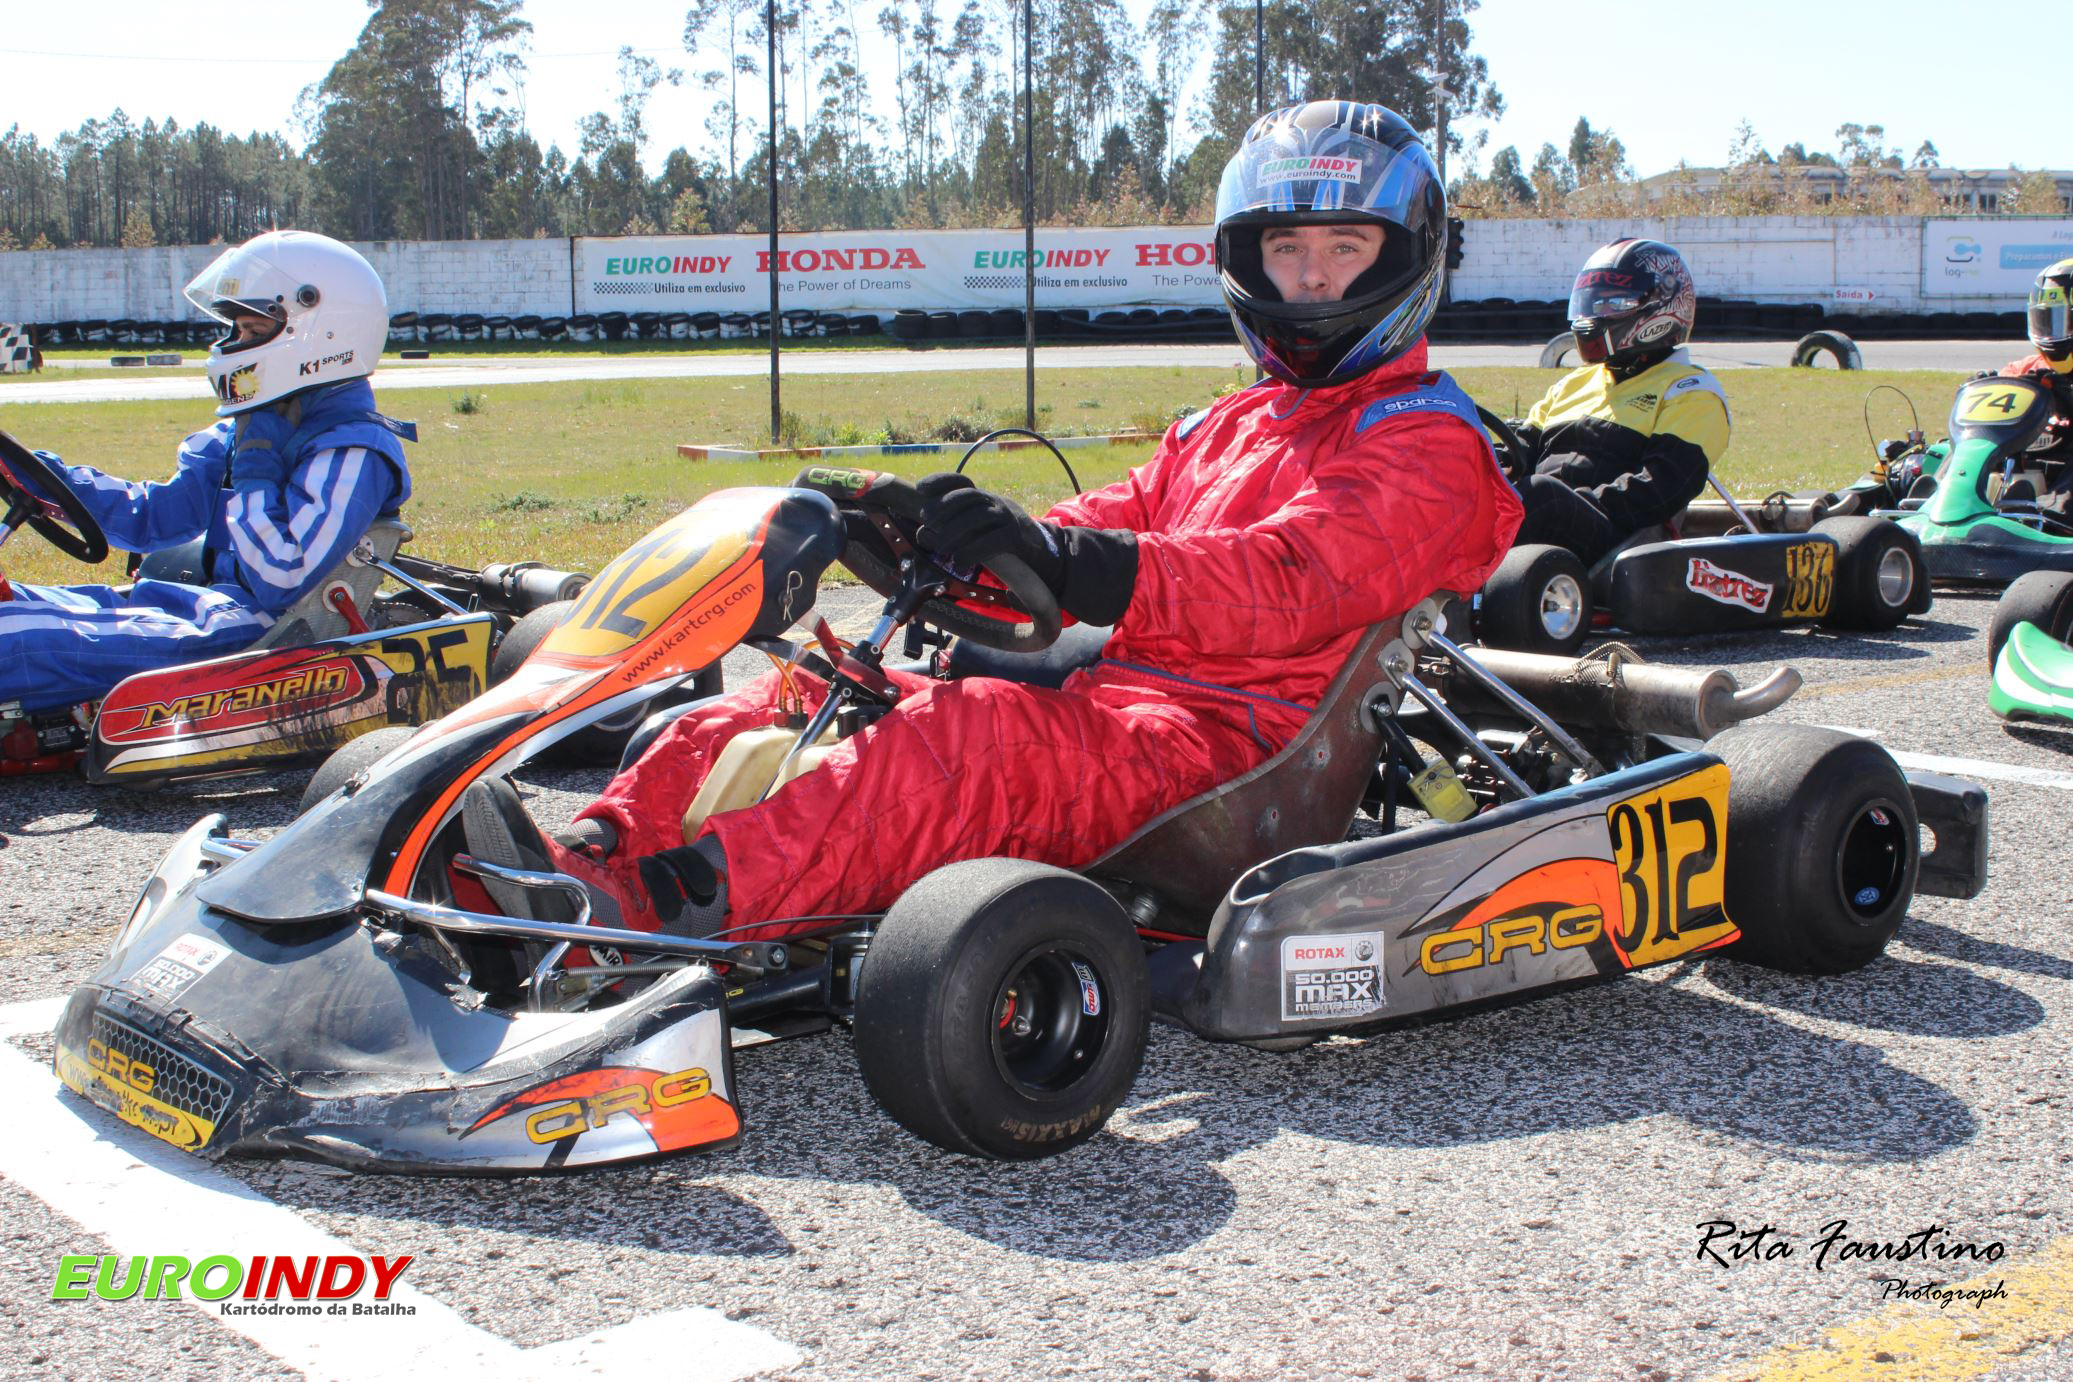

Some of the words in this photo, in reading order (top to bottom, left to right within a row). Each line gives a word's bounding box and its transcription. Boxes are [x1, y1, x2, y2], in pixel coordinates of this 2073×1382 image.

[1260, 169, 1356, 183] www.euroindy.com
[1262, 158, 1357, 176] EUROINDY
[605, 255, 732, 275] EUROINDY
[755, 248, 926, 272] HONDA
[974, 248, 1111, 269] EUROINDY
[654, 282, 685, 293] Utiliza
[687, 284, 702, 293] em
[704, 282, 746, 293] exclusivo
[778, 281, 794, 292] he
[798, 280, 839, 291] Power
[843, 279, 856, 290] of
[860, 278, 912, 290] Dreams
[1064, 279, 1080, 287] em
[1082, 276, 1128, 287] exclusivo
[1152, 274, 1179, 286] The
[1184, 274, 1222, 286] Powe
[1642, 321, 1672, 338] LAZER
[299, 359, 320, 376] K1
[322, 350, 354, 365] SPORTS
[1383, 398, 1457, 412] sparco
[1968, 392, 2017, 414] 74
[622, 581, 757, 684] www.kartcrg.com
[1609, 796, 1729, 953] 312
[1420, 903, 1604, 975] CRG
[1295, 947, 1345, 960] ROTAX
[1295, 969, 1374, 985] 50.000
[88, 1038, 155, 1093] CRG
[525, 1067, 712, 1145] CRG
